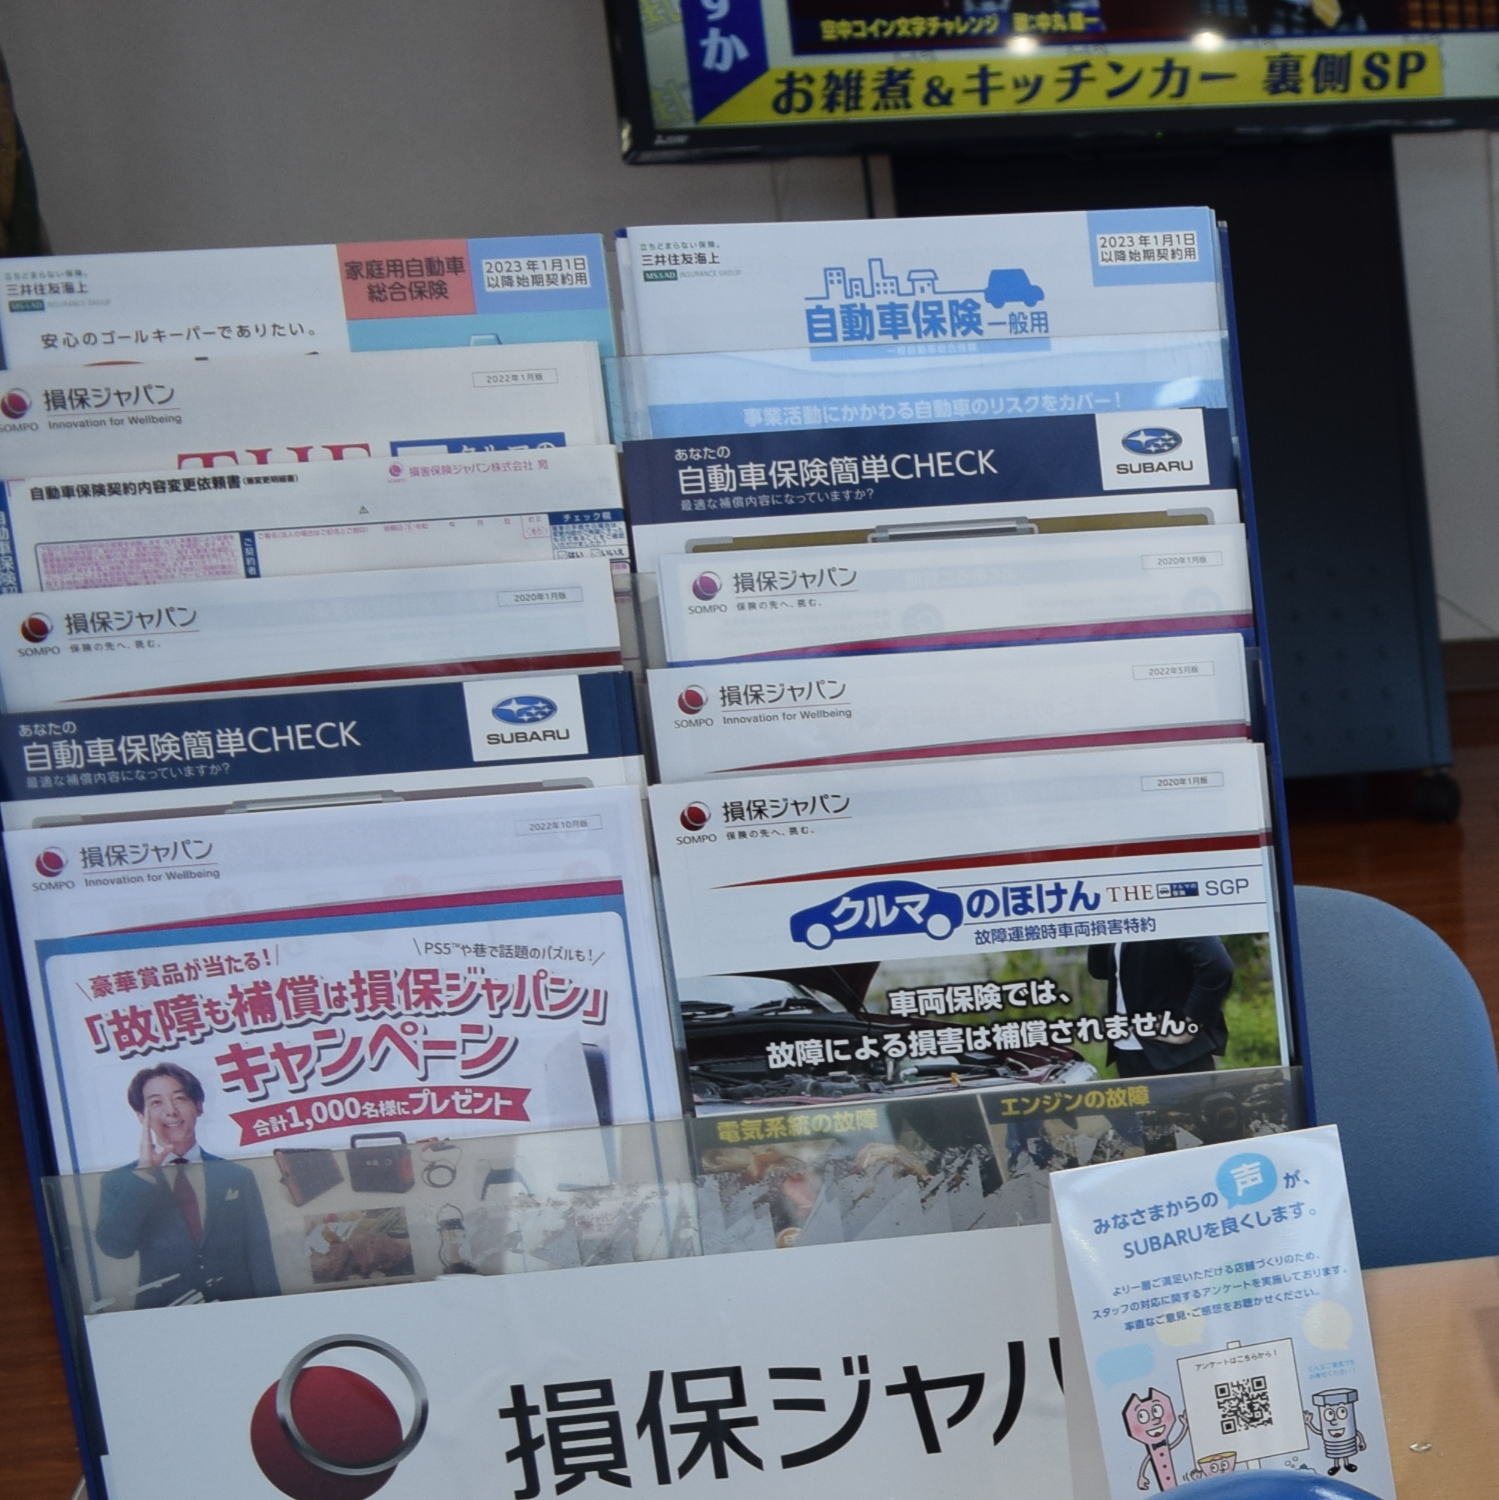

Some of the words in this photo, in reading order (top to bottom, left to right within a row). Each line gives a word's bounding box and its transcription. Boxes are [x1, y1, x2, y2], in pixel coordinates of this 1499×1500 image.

[345, 254, 466, 281] 家庭用自動車
[641, 252, 721, 266] 三井住友海上
[1100, 247, 1198, 265] 以降始期契約用
[6, 281, 89, 296] 三井住友海上
[367, 281, 448, 304] 総合保険
[486, 272, 588, 290] 以降始期契約用
[805, 298, 984, 345] 自動車保険
[988, 311, 1050, 336] 一般用
[41, 323, 316, 349] 安心のゴールキーパーでありたい。
[42, 384, 175, 412] 損保ジャパン
[48, 418, 106, 430] Innovation
[109, 416, 124, 426] for
[127, 413, 182, 426] Wellbeing
[674, 446, 731, 461] あなたの
[678, 448, 998, 497] 自動車保険簡単CHECK
[1116, 459, 1194, 476] SUBARU
[732, 566, 858, 594] 損保ジャパン
[65, 607, 198, 635] 損保ジャパン
[688, 603, 728, 615] SOMPO
[18, 645, 61, 658] SOMPO
[719, 678, 847, 708] 損保ジャパン
[18, 719, 77, 737] あなたの
[674, 717, 715, 729] SOMPO
[722, 711, 778, 724] Innovation
[781, 711, 796, 721] for
[798, 707, 852, 722] Wellbeing
[23, 719, 361, 774] 自動車保険簡単CHECK
[486, 728, 571, 745] SUBARU
[722, 793, 851, 824] 損保ジャパン
[676, 833, 718, 846] SOMPO
[81, 839, 213, 869] 損保ジャパン
[32, 879, 75, 892] SOMPO
[84, 874, 143, 888] Innovation
[147, 872, 161, 883] for
[164, 868, 221, 882] Wellbeing
[1106, 884, 1155, 903] THE
[1205, 878, 1250, 897] SGP
[974, 916, 1157, 946] 故障運搬時車両損害特約
[83, 964, 609, 1058] 「故障も補償は損保ジャパン」
[889, 980, 1072, 1019] 車両保険では、
[765, 1010, 1200, 1071] 故障による損害は補償されません。
[213, 1022, 518, 1101] キャンペーン
[1000, 1084, 1150, 1116] エンジンの故障
[716, 1108, 880, 1144] 電気系統の故障
[1123, 1201, 1317, 1258] SUBARUを良くします。
